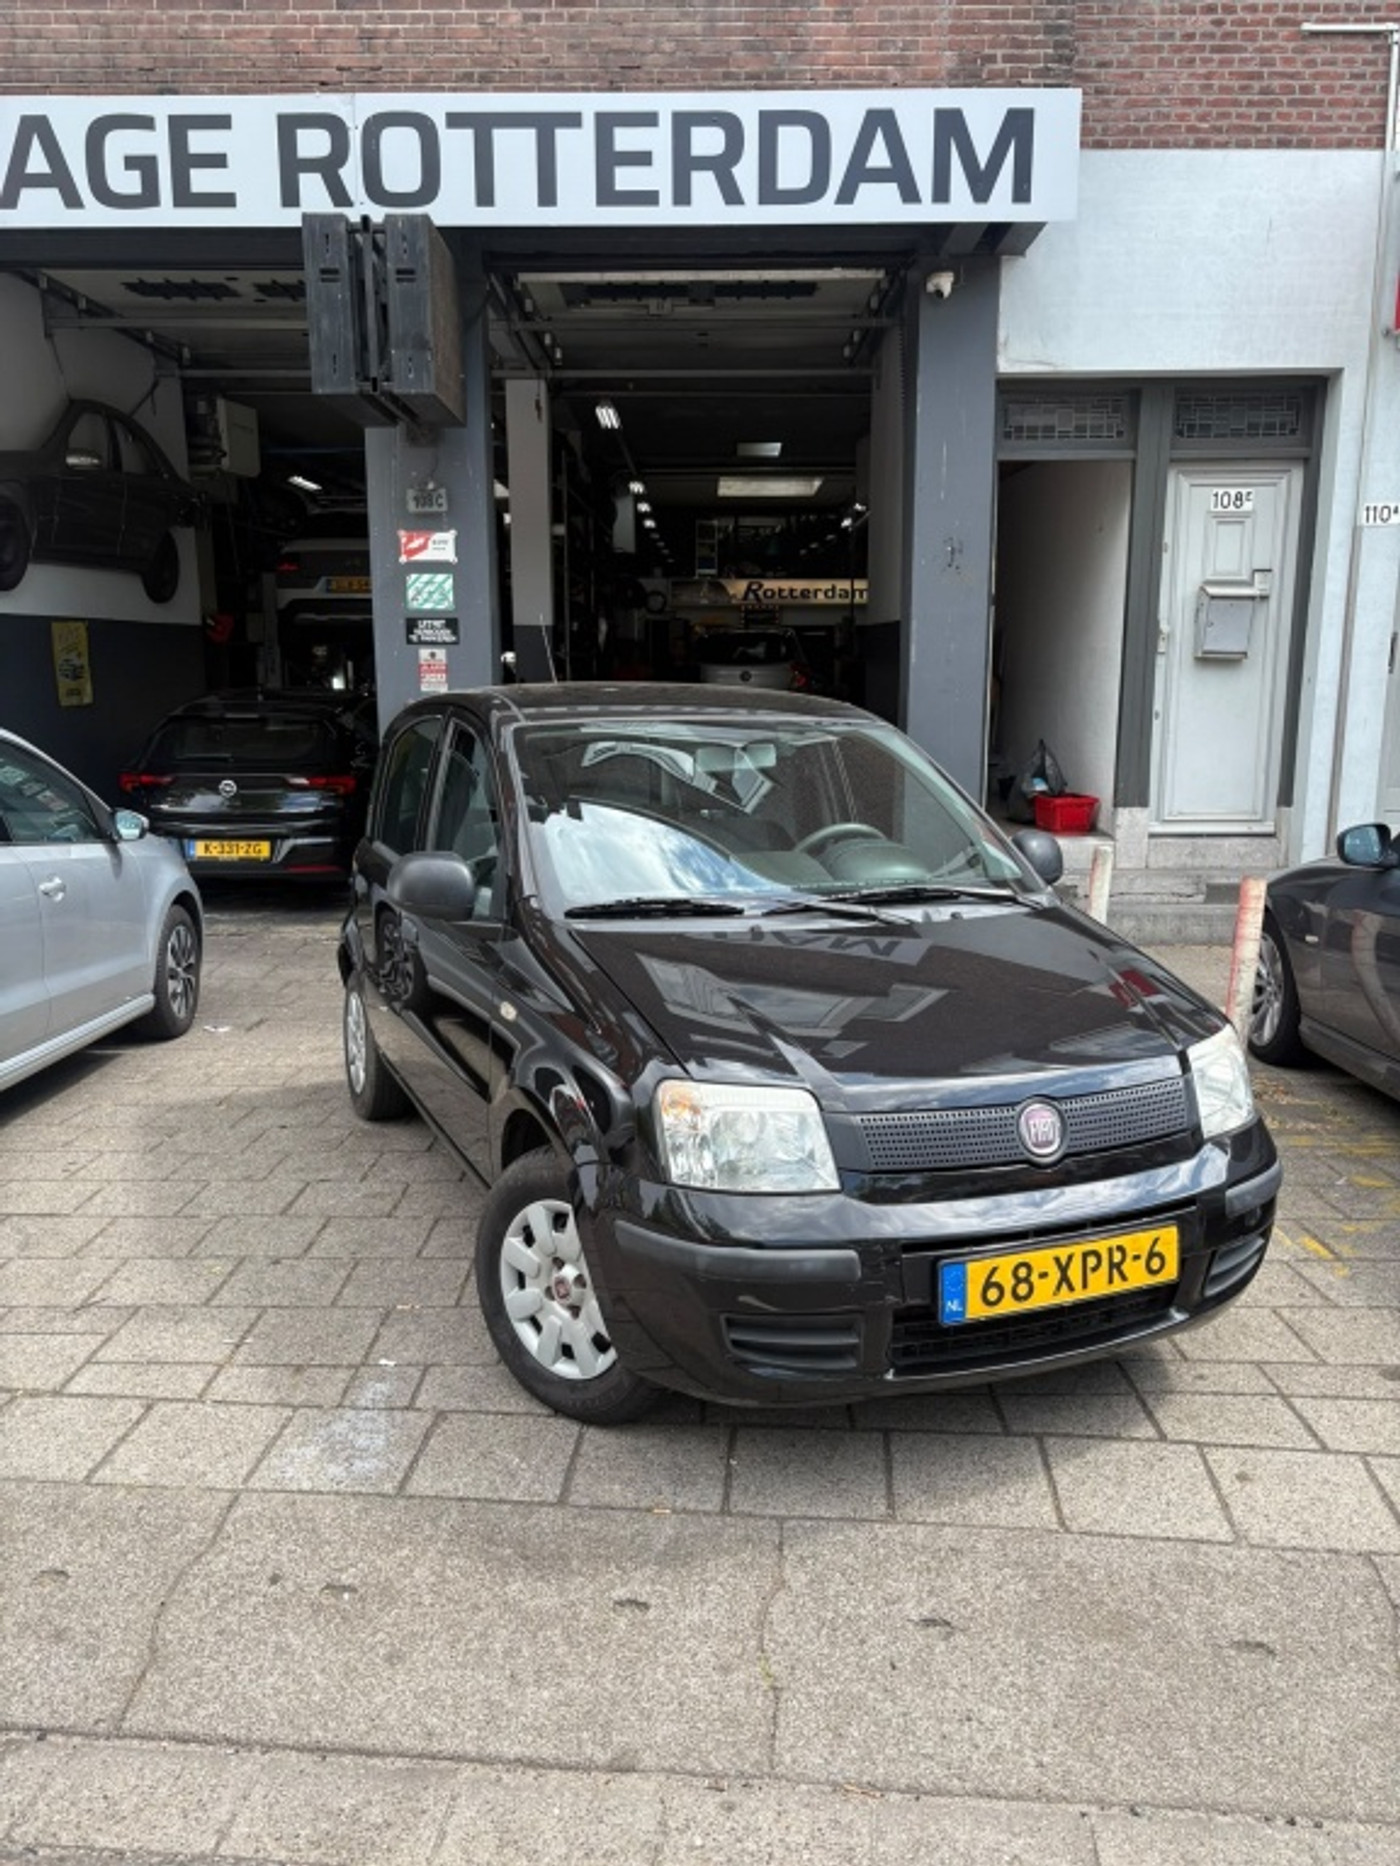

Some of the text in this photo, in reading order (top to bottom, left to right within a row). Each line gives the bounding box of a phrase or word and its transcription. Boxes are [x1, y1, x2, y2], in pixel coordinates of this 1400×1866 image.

[0, 107, 1035, 209] AGE ROTTERDAM
[742, 581, 867, 603] Rotterdam
[981, 1237, 1166, 1307] 68-XPR-6
